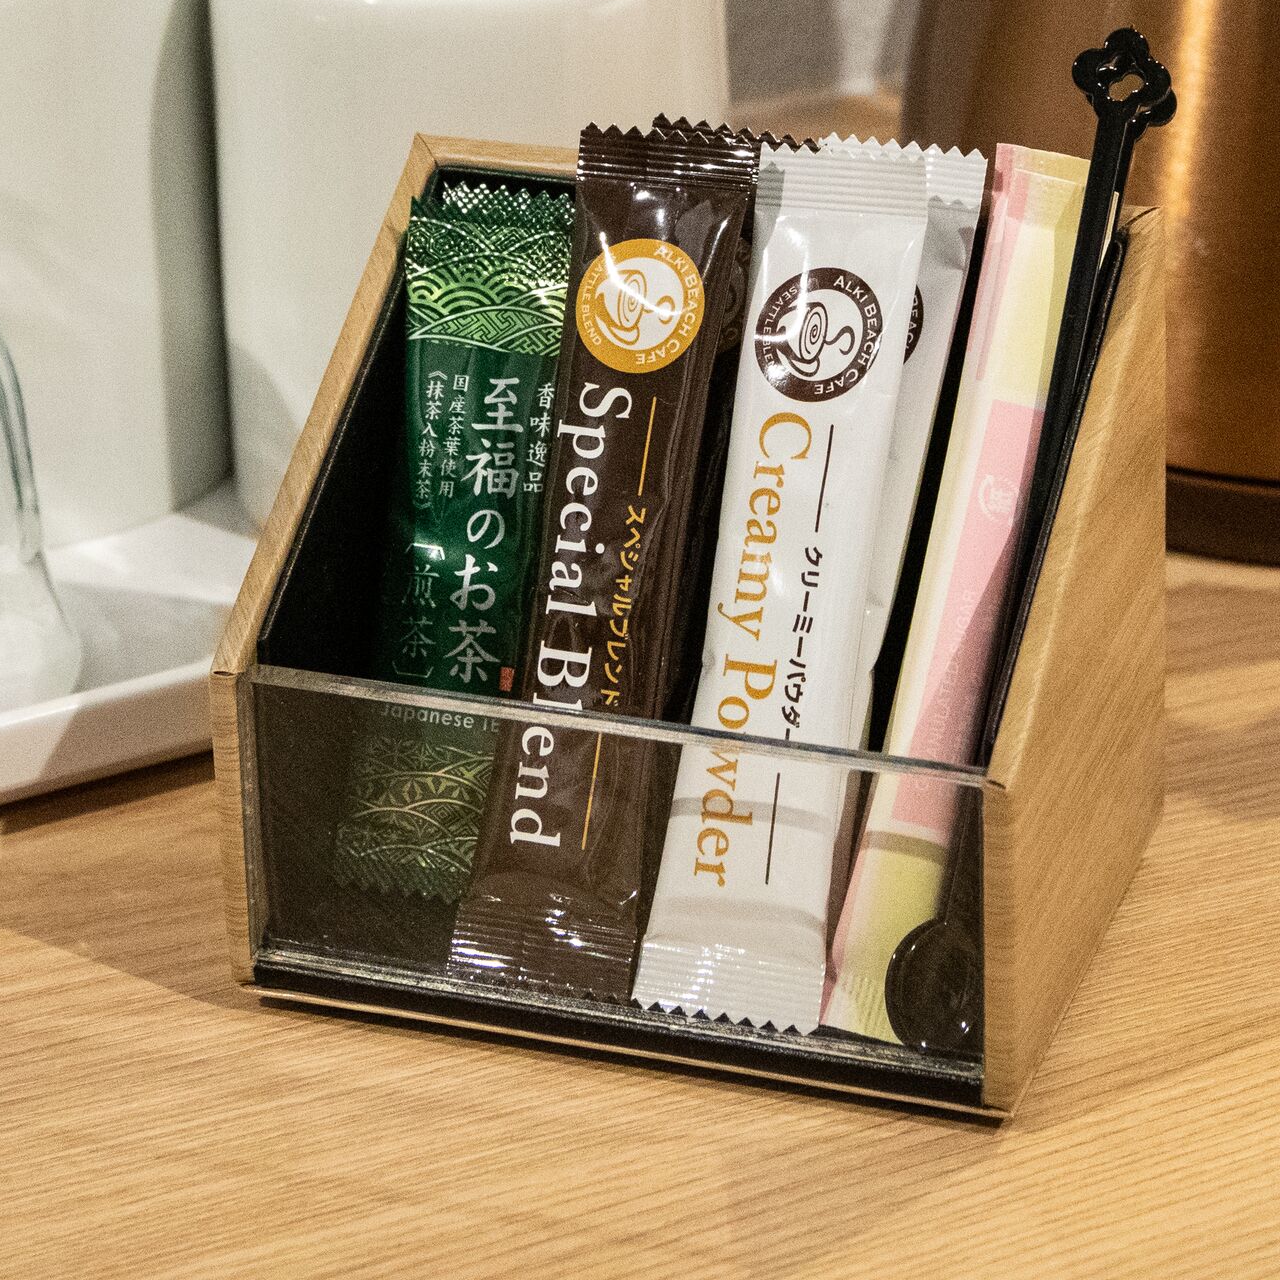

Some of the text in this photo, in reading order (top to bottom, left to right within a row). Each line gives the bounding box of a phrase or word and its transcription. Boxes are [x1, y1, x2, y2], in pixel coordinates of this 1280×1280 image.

[580, 304, 602, 347] BLEND
[635, 245, 700, 365] ALKI BEACH CAFE
[762, 285, 798, 335] SEATTLE
[813, 275, 878, 395] ALKI BEACH CAFE
[439, 374, 470, 499] 国産茶葉使用
[522, 382, 555, 493] 香味逸品
[442, 377, 524, 683] 至福のお茶
[509, 382, 634, 848] Special Blend
[598, 504, 647, 708] スペシャルブレンド
[693, 411, 813, 888] Creamy Powder
[781, 546, 824, 741] クリーミーパウダー
[381, 703, 475, 730] Japanese
